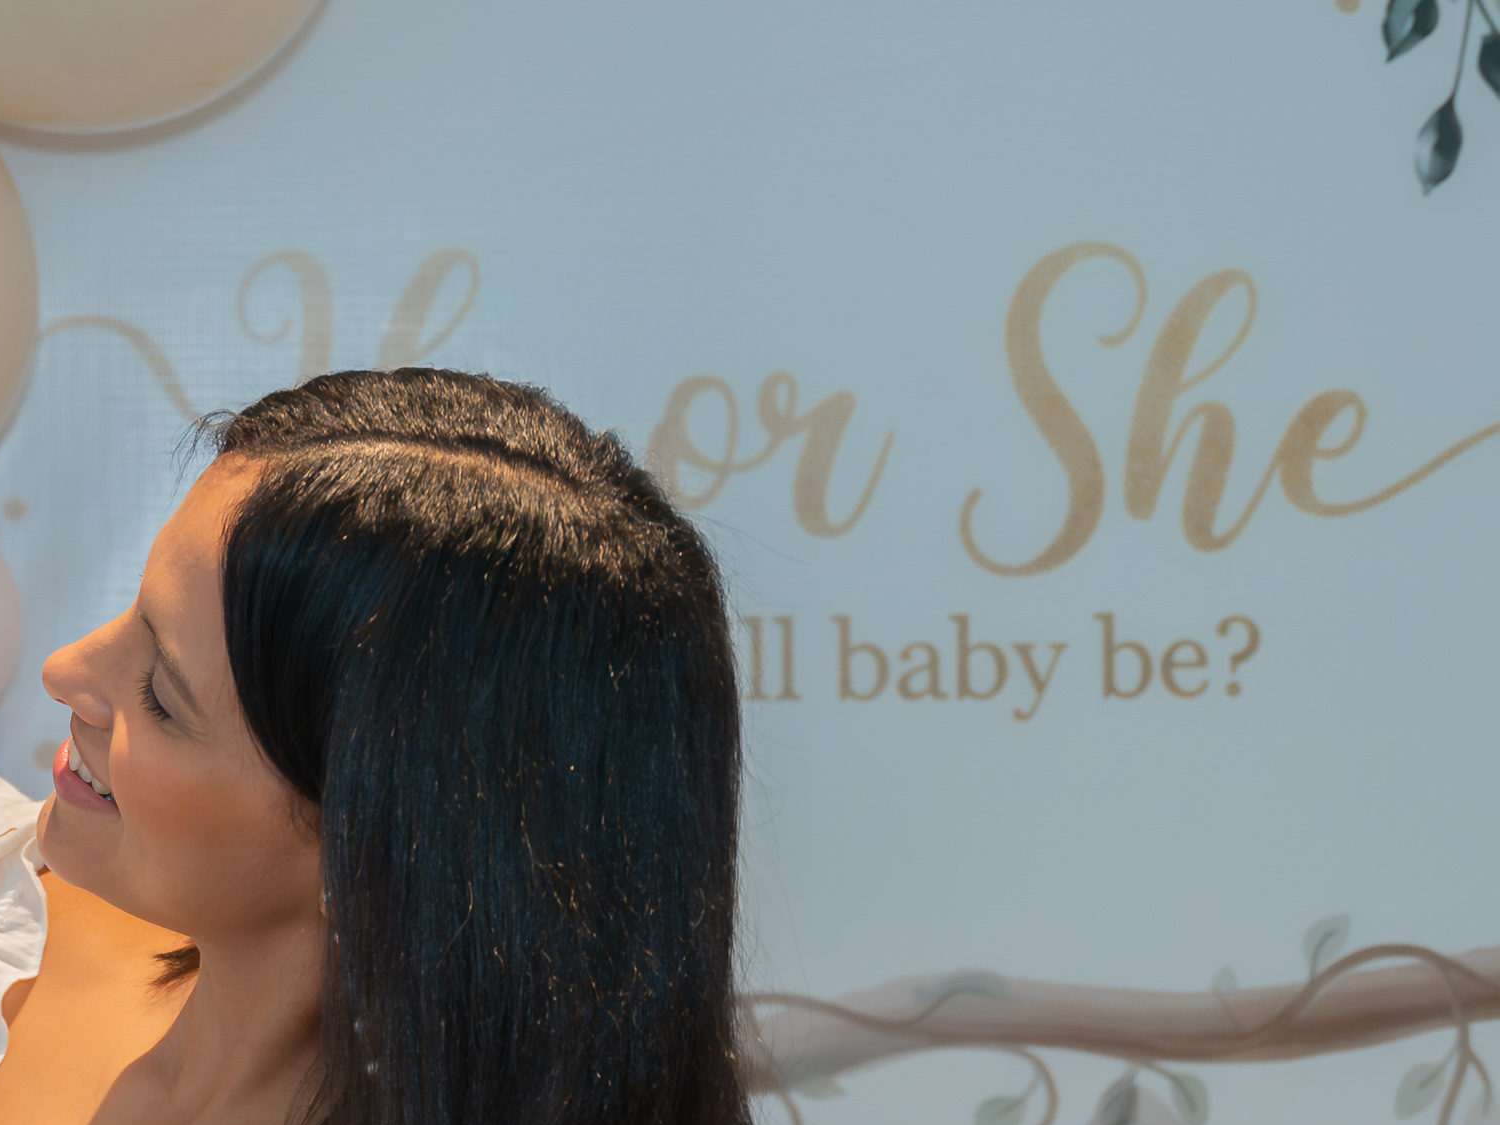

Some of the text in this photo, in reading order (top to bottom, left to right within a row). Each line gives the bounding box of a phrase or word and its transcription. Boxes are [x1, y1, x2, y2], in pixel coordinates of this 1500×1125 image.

[651, 241, 1500, 578] or She
[742, 611, 1261, 722] ll baby be?
